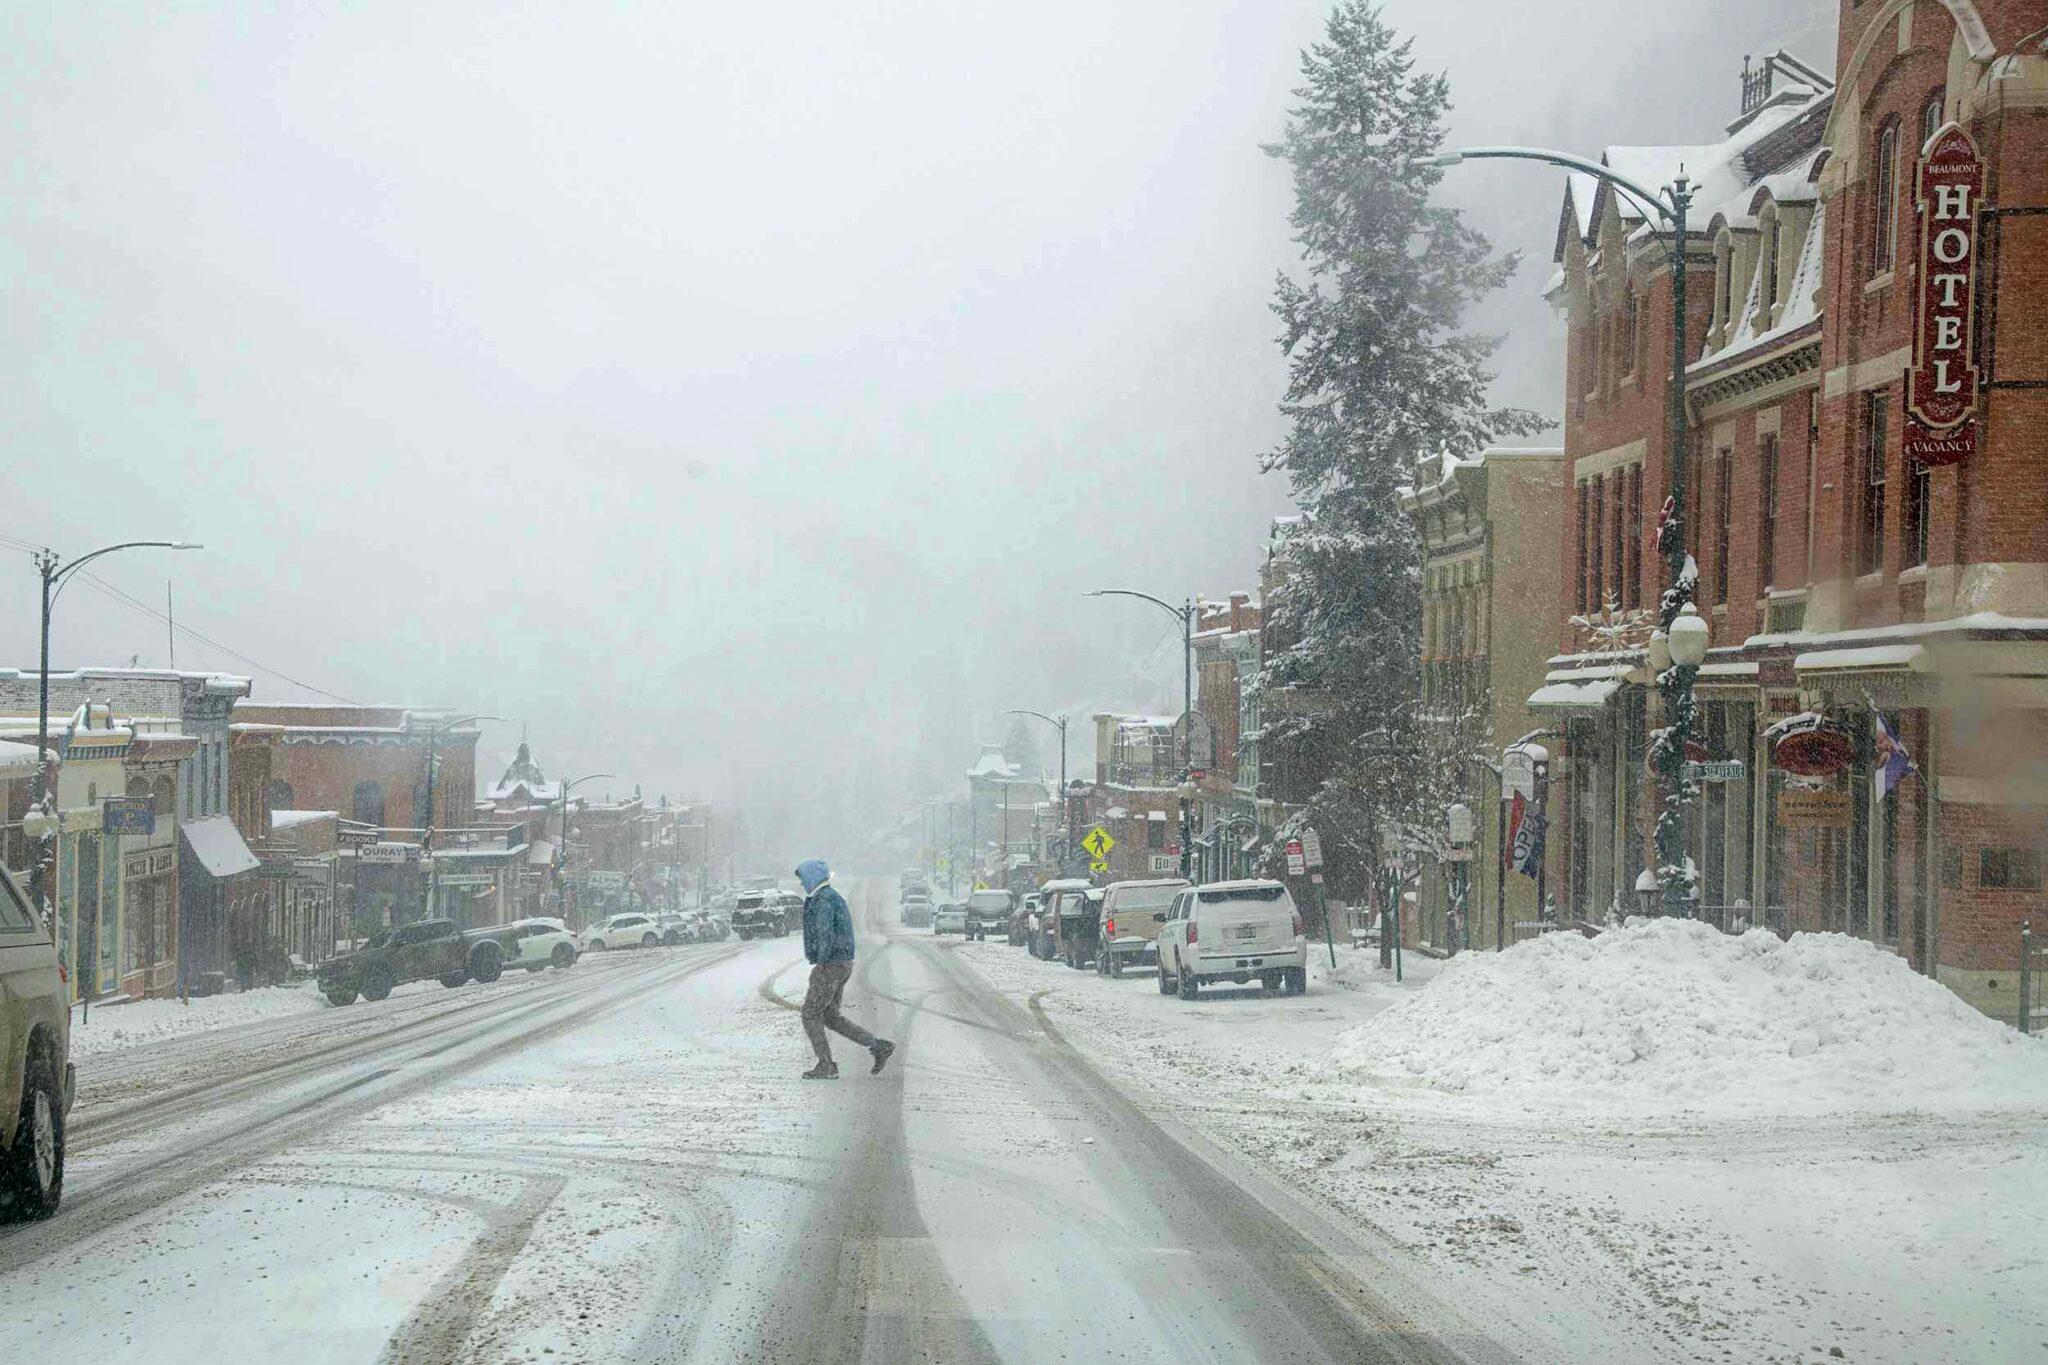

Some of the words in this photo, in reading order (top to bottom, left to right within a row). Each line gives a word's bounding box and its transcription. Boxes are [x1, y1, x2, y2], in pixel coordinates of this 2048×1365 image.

[1929, 165, 1978, 174] BEAUMONT
[1934, 185, 1971, 393] HOTEL
[1912, 440, 1973, 452] VACANCY
[1716, 765, 1744, 777] AVENUE
[345, 835, 377, 844] BOOKS
[363, 847, 403, 856] OURAY
